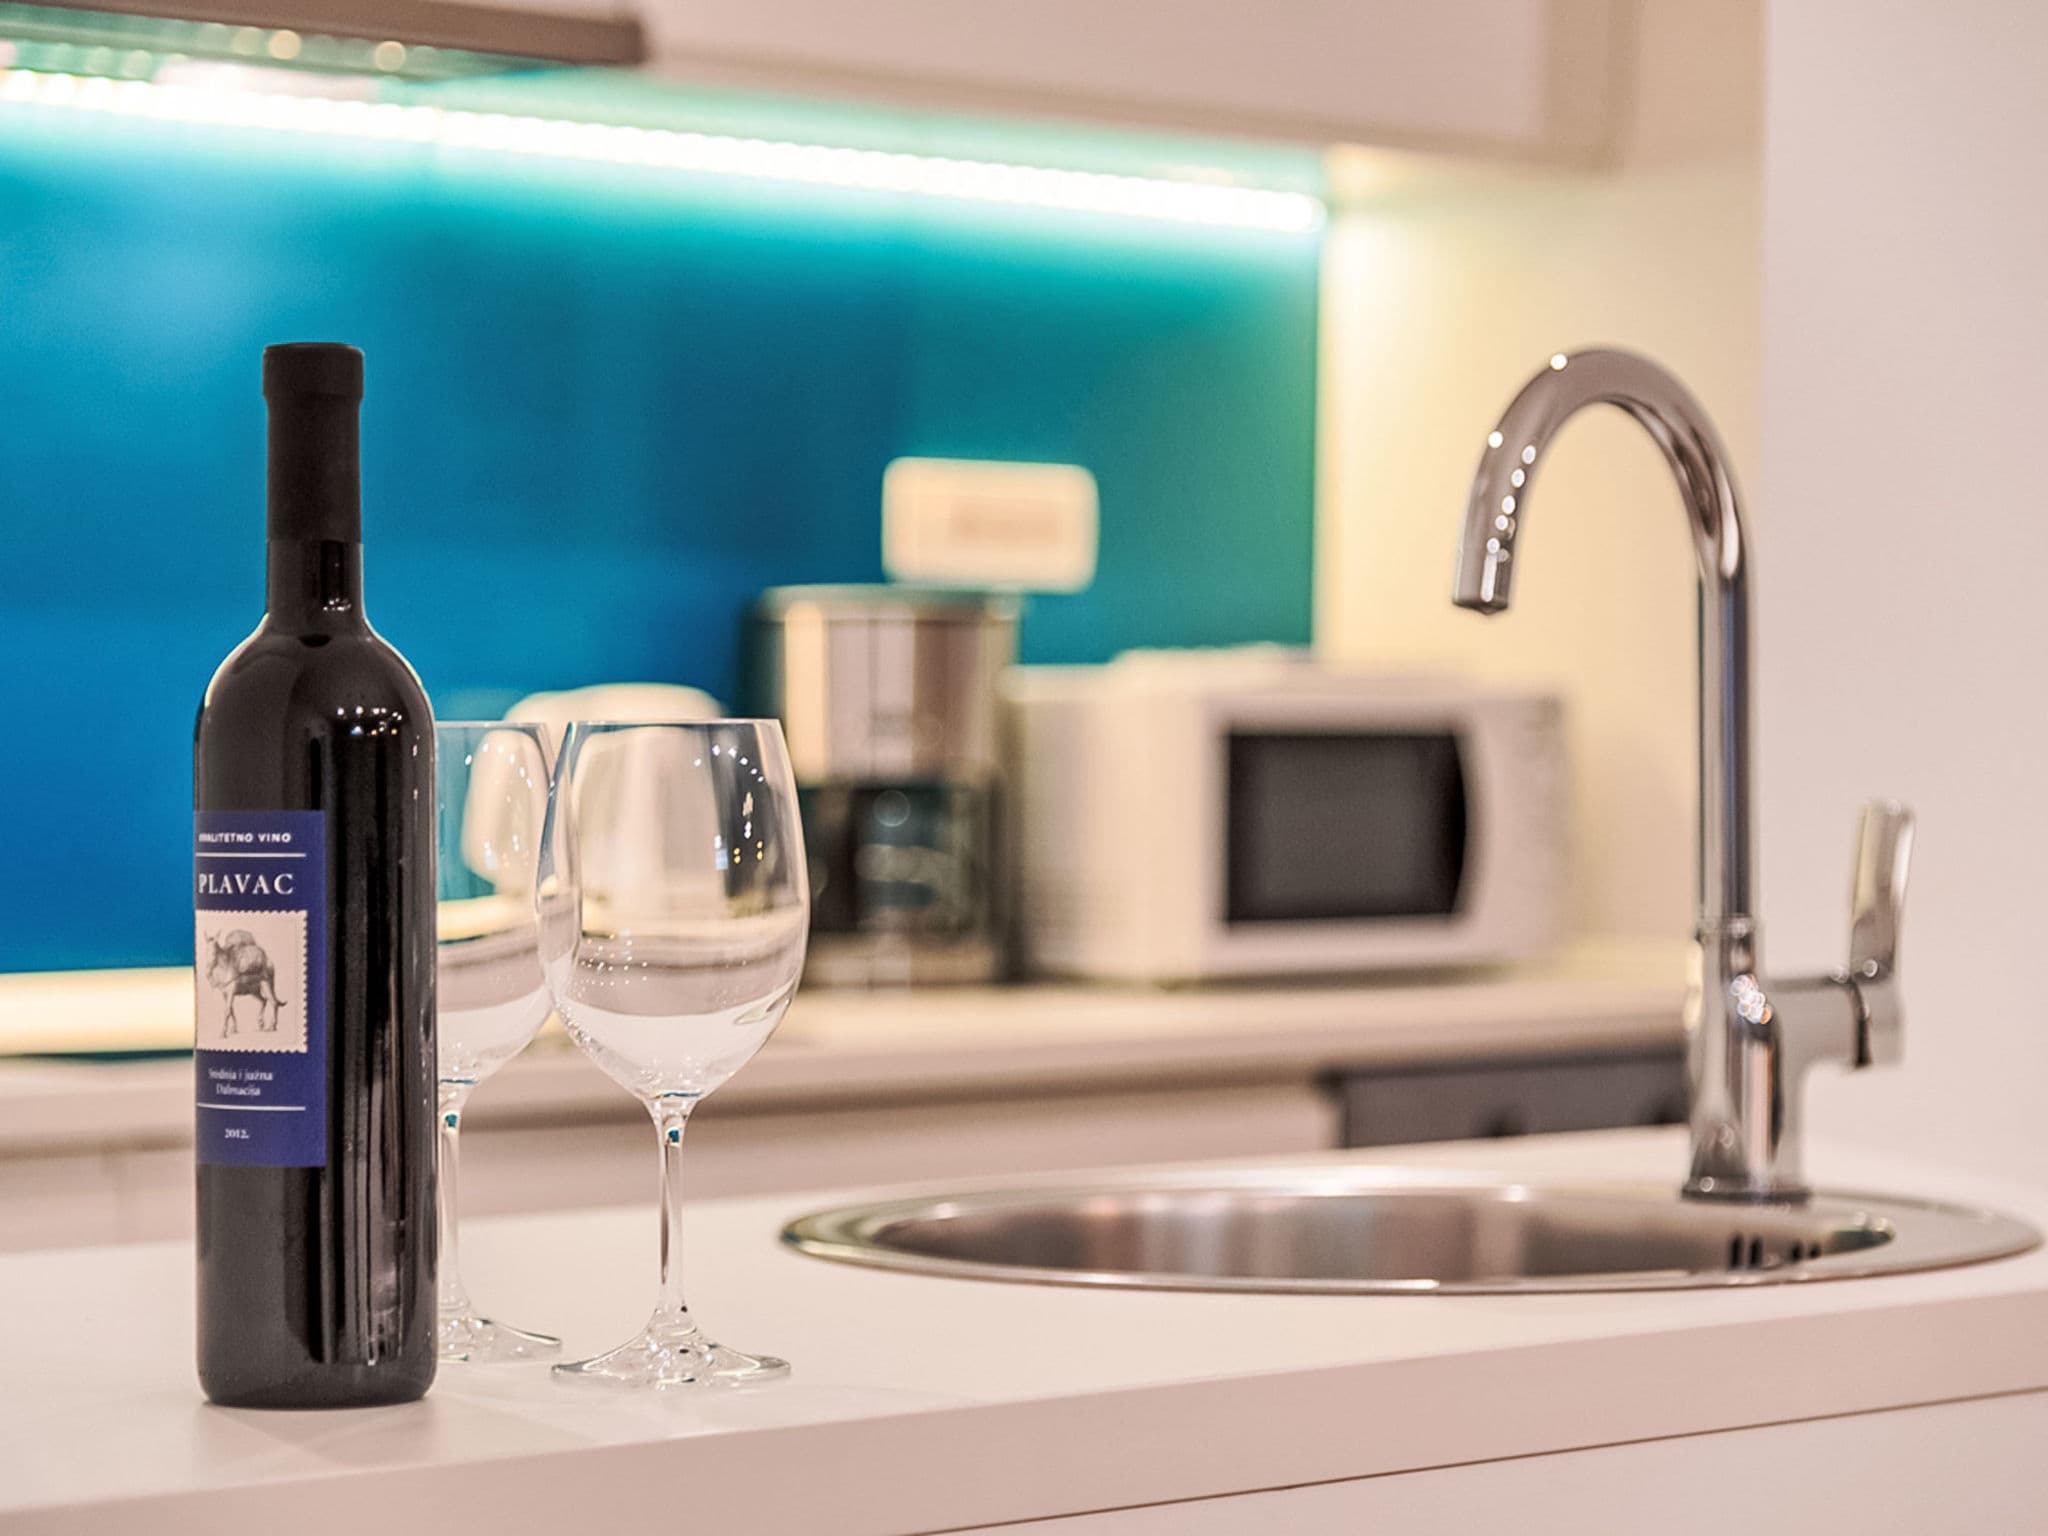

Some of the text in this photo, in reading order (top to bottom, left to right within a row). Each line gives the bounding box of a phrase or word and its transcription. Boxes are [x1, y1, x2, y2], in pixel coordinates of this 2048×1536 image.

[258, 832, 292, 843] VINO
[198, 873, 295, 895] PLAVAC
[224, 1128, 250, 1139] 2012.
